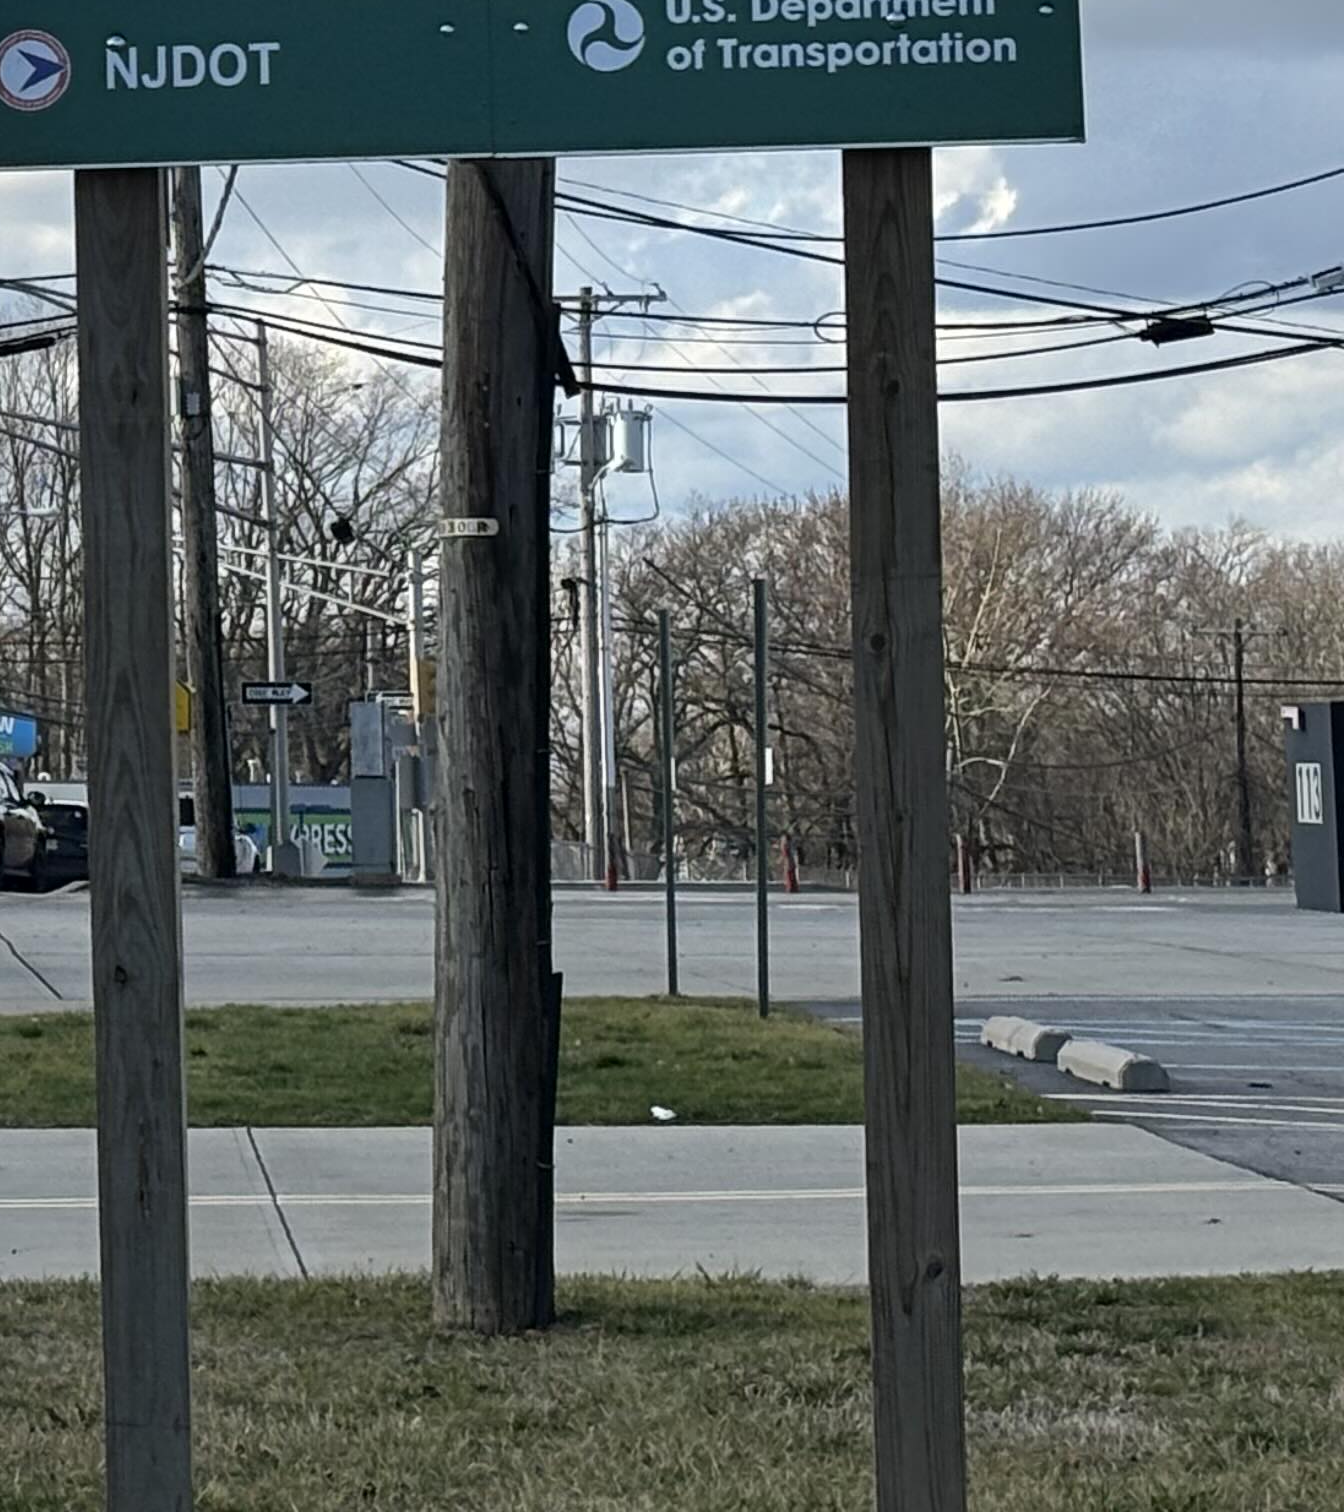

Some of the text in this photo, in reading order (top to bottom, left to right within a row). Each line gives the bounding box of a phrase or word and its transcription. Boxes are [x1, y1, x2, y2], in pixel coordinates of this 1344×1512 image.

[104, 42, 282, 90] NJDOT
[665, 31, 1018, 74] of Transportation
[1298, 766, 1320, 820] 113
